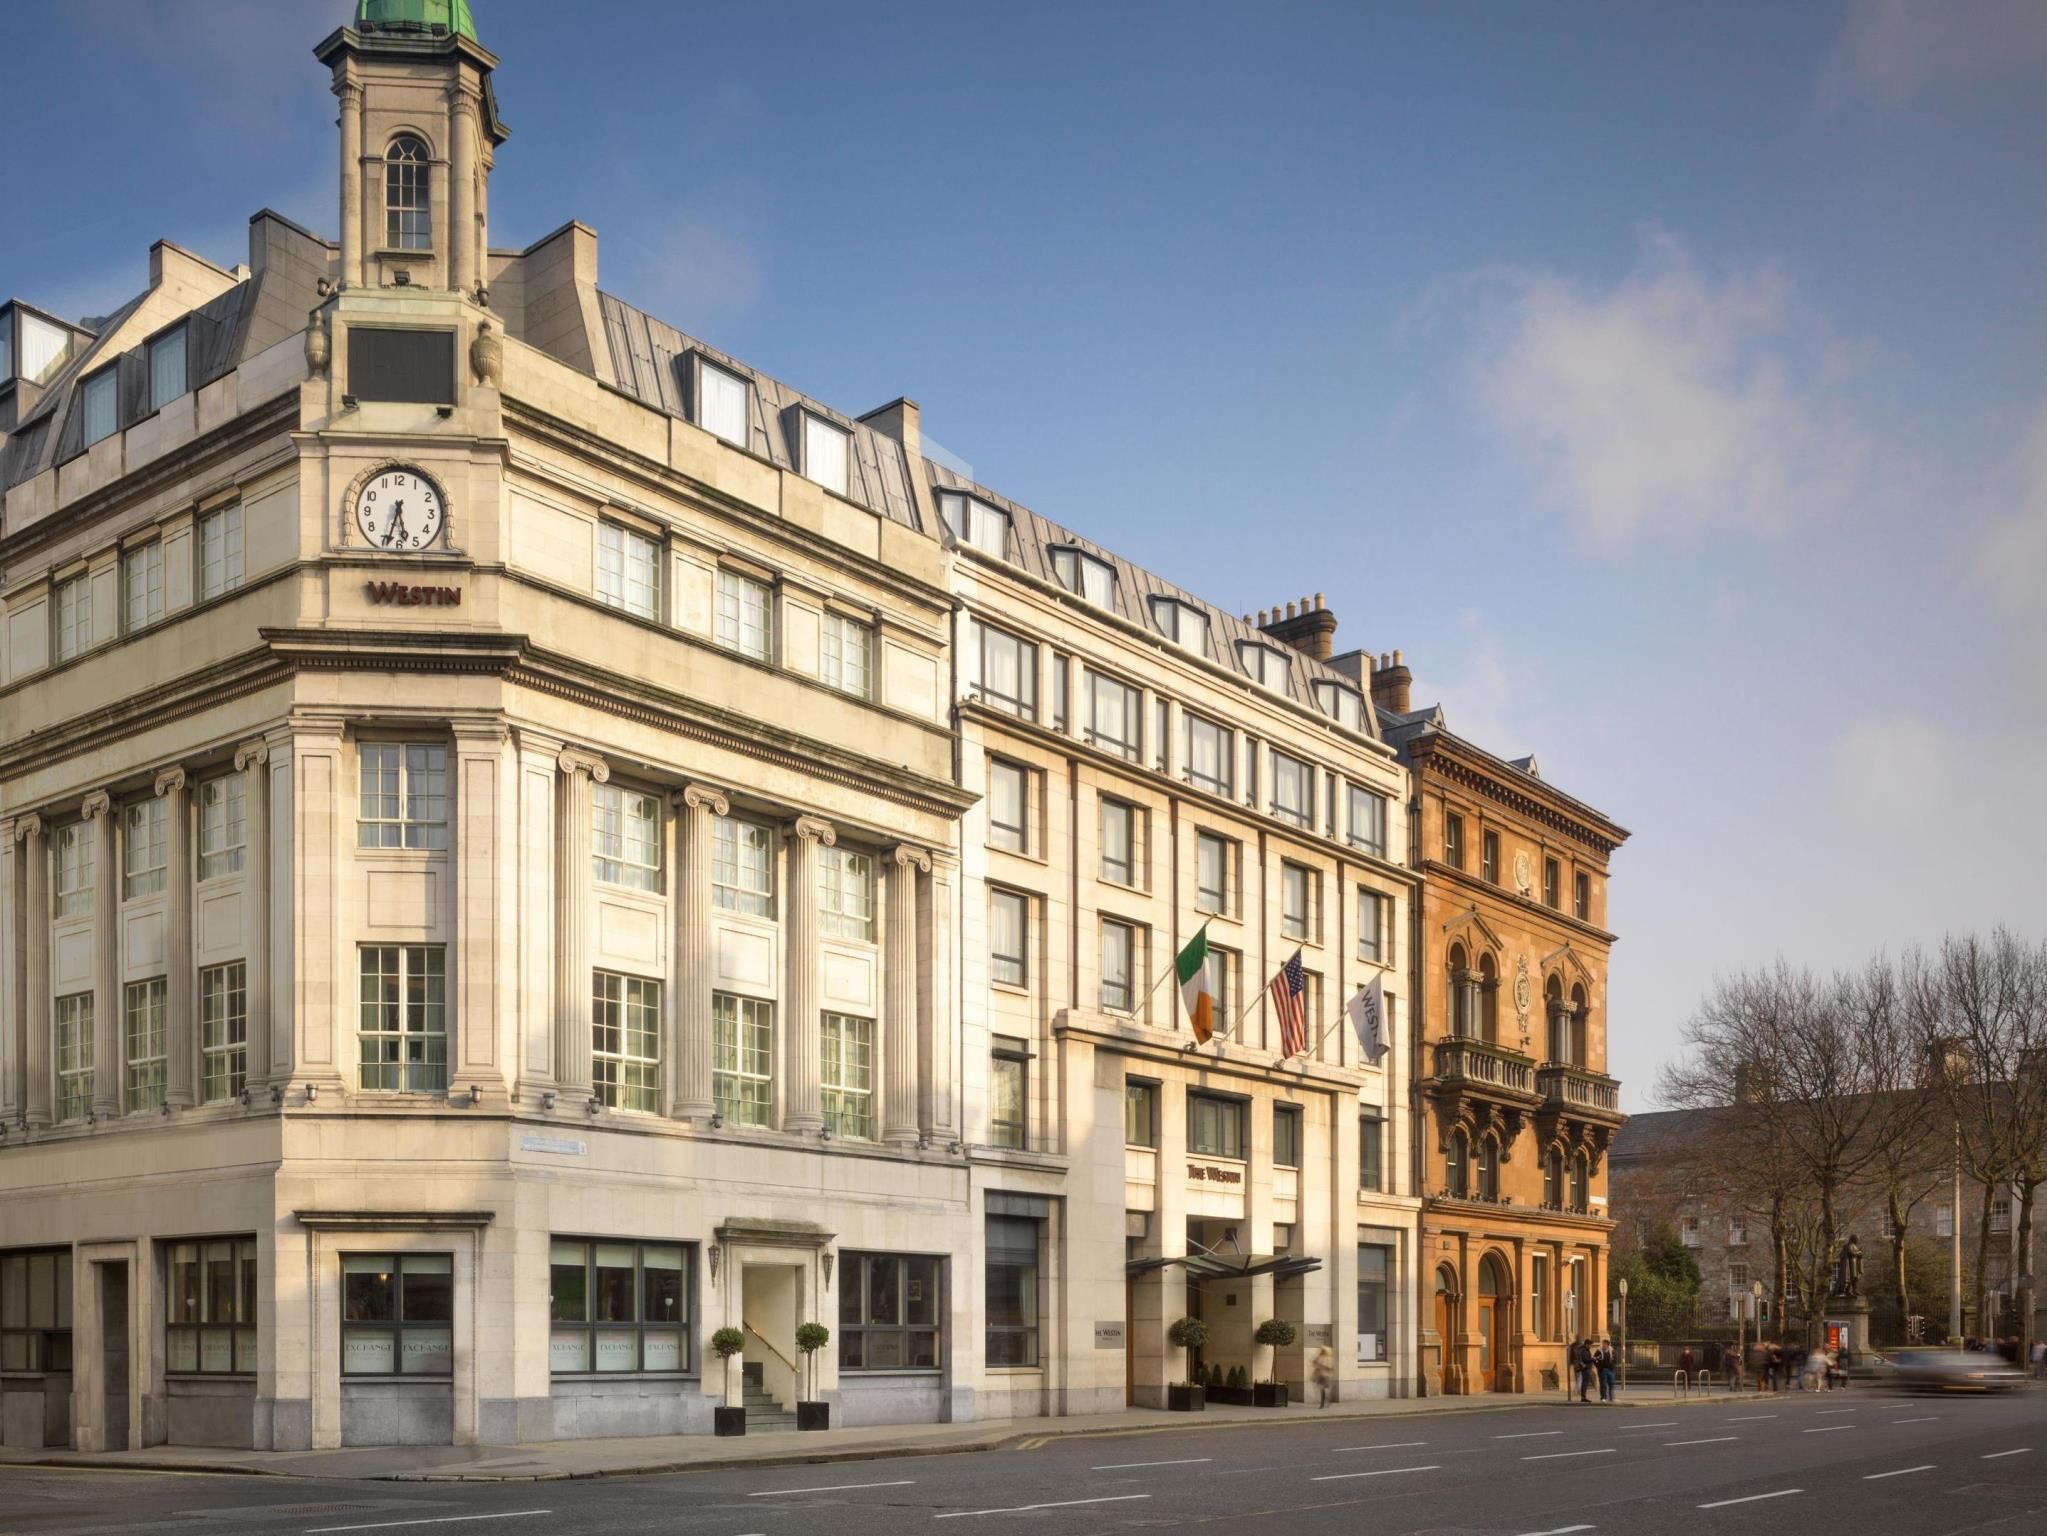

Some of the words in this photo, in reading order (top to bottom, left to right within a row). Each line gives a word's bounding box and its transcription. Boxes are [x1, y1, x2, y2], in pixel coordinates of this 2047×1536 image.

[381, 478, 388, 489] 11
[394, 474, 405, 486] 12
[413, 479, 417, 490] 1
[367, 490, 377, 502] 10
[424, 491, 432, 503] 2
[363, 505, 371, 517] 9
[427, 508, 435, 520] 3
[368, 521, 375, 532] 8
[422, 523, 430, 534] 4
[380, 534, 389, 546] 7
[395, 539, 403, 550] 6
[412, 536, 420, 547] 5
[367, 581, 462, 607] WESTIN
[1186, 1164, 1206, 1181] THE
[1206, 1166, 1241, 1184] WESTIN
[552, 1343, 585, 1352] XCHANGE
